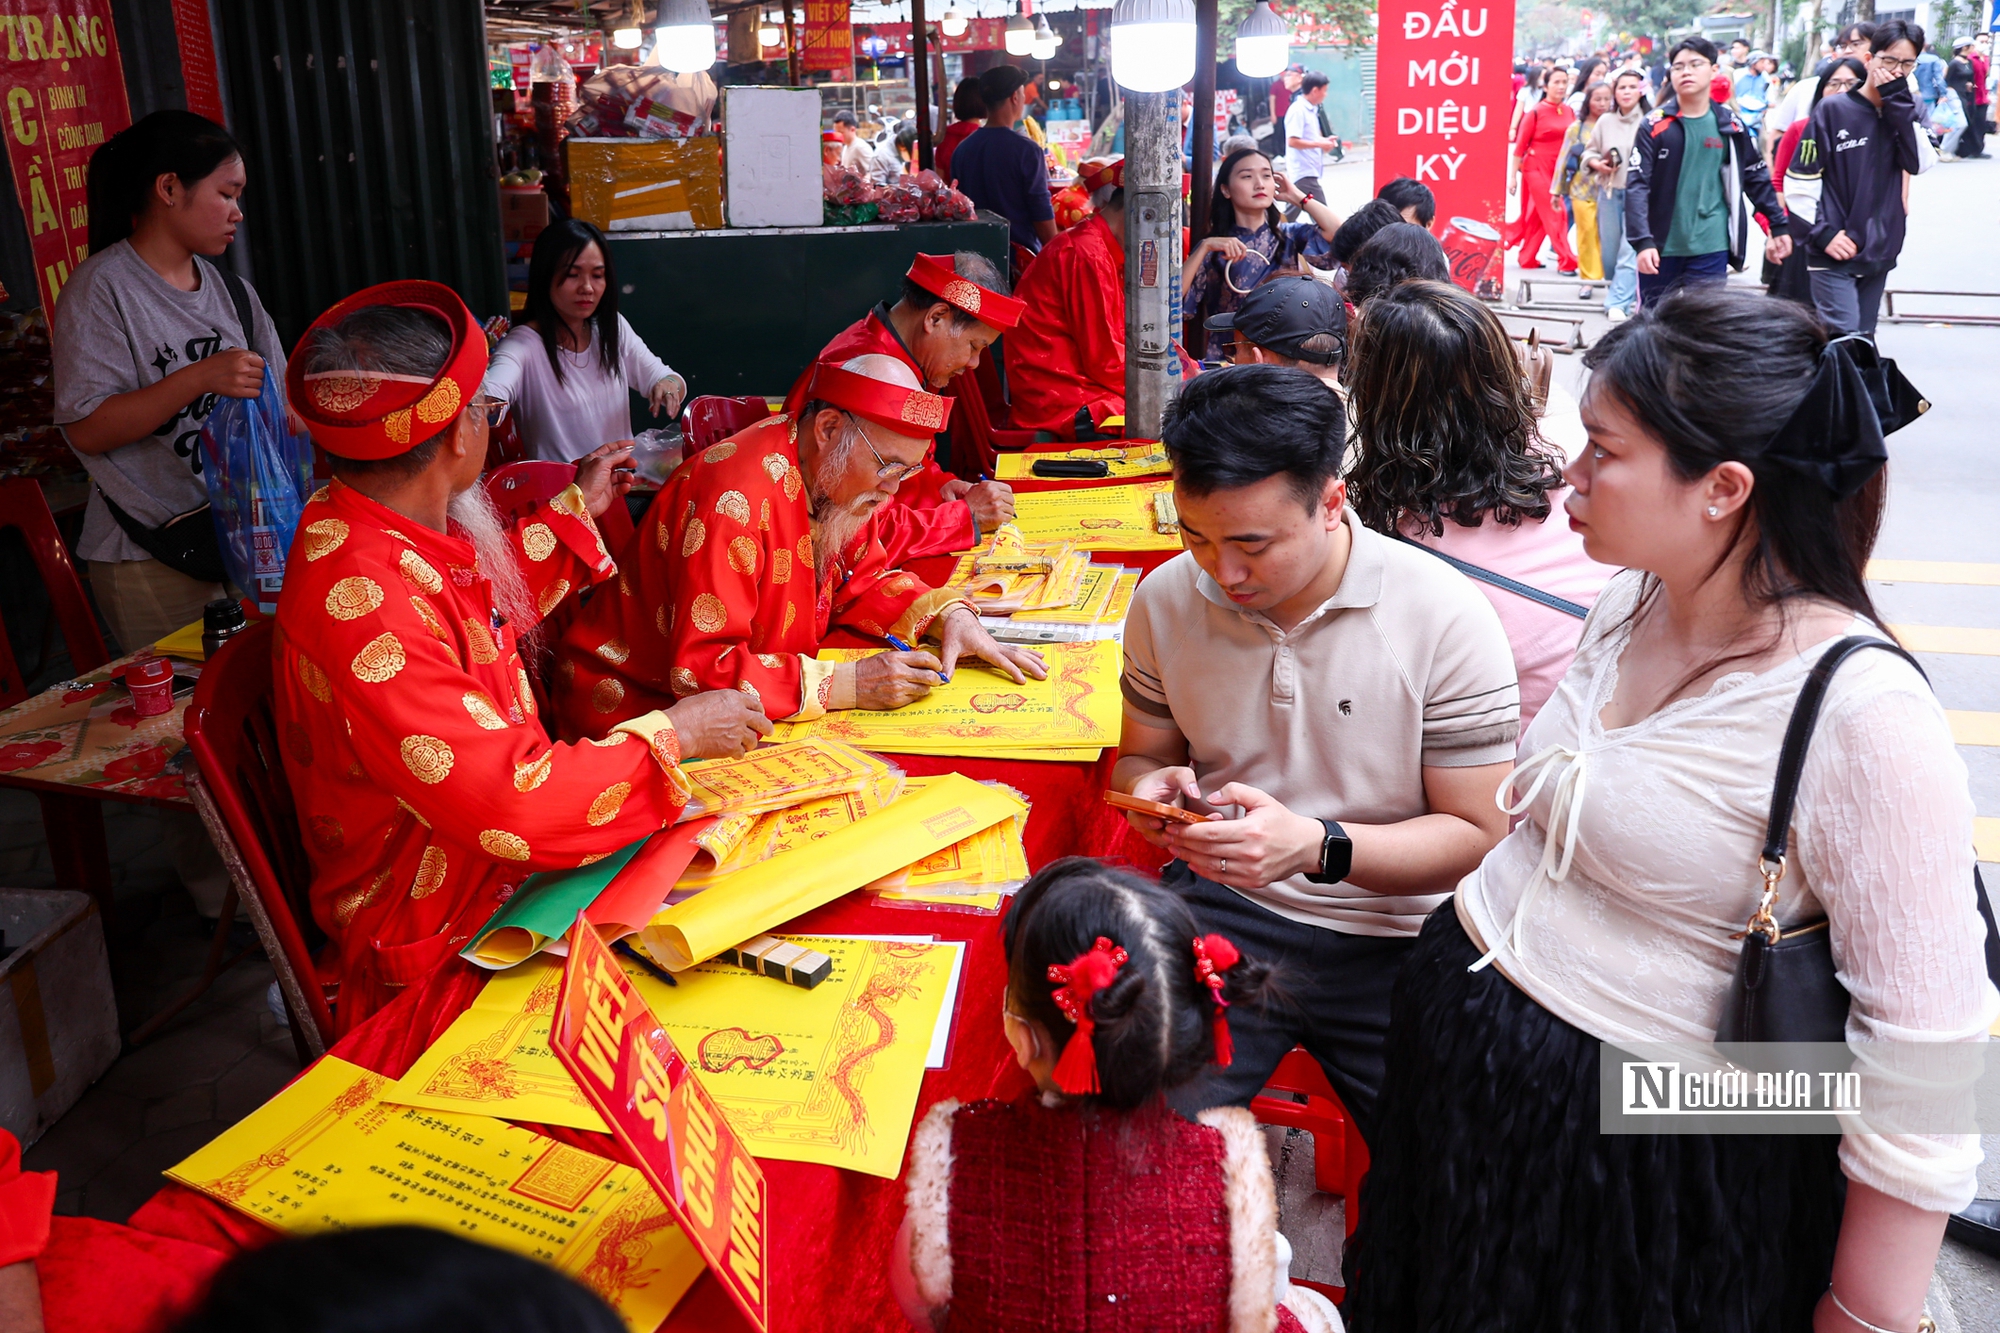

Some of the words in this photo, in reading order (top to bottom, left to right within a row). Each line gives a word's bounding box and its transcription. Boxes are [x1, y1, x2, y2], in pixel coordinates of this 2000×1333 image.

[808, 0, 830, 22] VIẾT
[1402, 0, 1488, 40] ĐẦU
[0, 14, 107, 72] TRẠNG
[830, 29, 851, 48] NHO
[1408, 50, 1479, 87] MỚI
[48, 82, 76, 111] BÌNH
[57, 121, 85, 150] CÔNG
[84, 121, 105, 145] DANH
[1397, 98, 1487, 141] DIỆU
[63, 166, 82, 190] THI
[1415, 146, 1467, 181] KỲ
[577, 954, 627, 1091] VIẾT
[634, 1033, 671, 1142] SỚ
[681, 1079, 718, 1229] CHỮ
[729, 1156, 760, 1303] NHO
